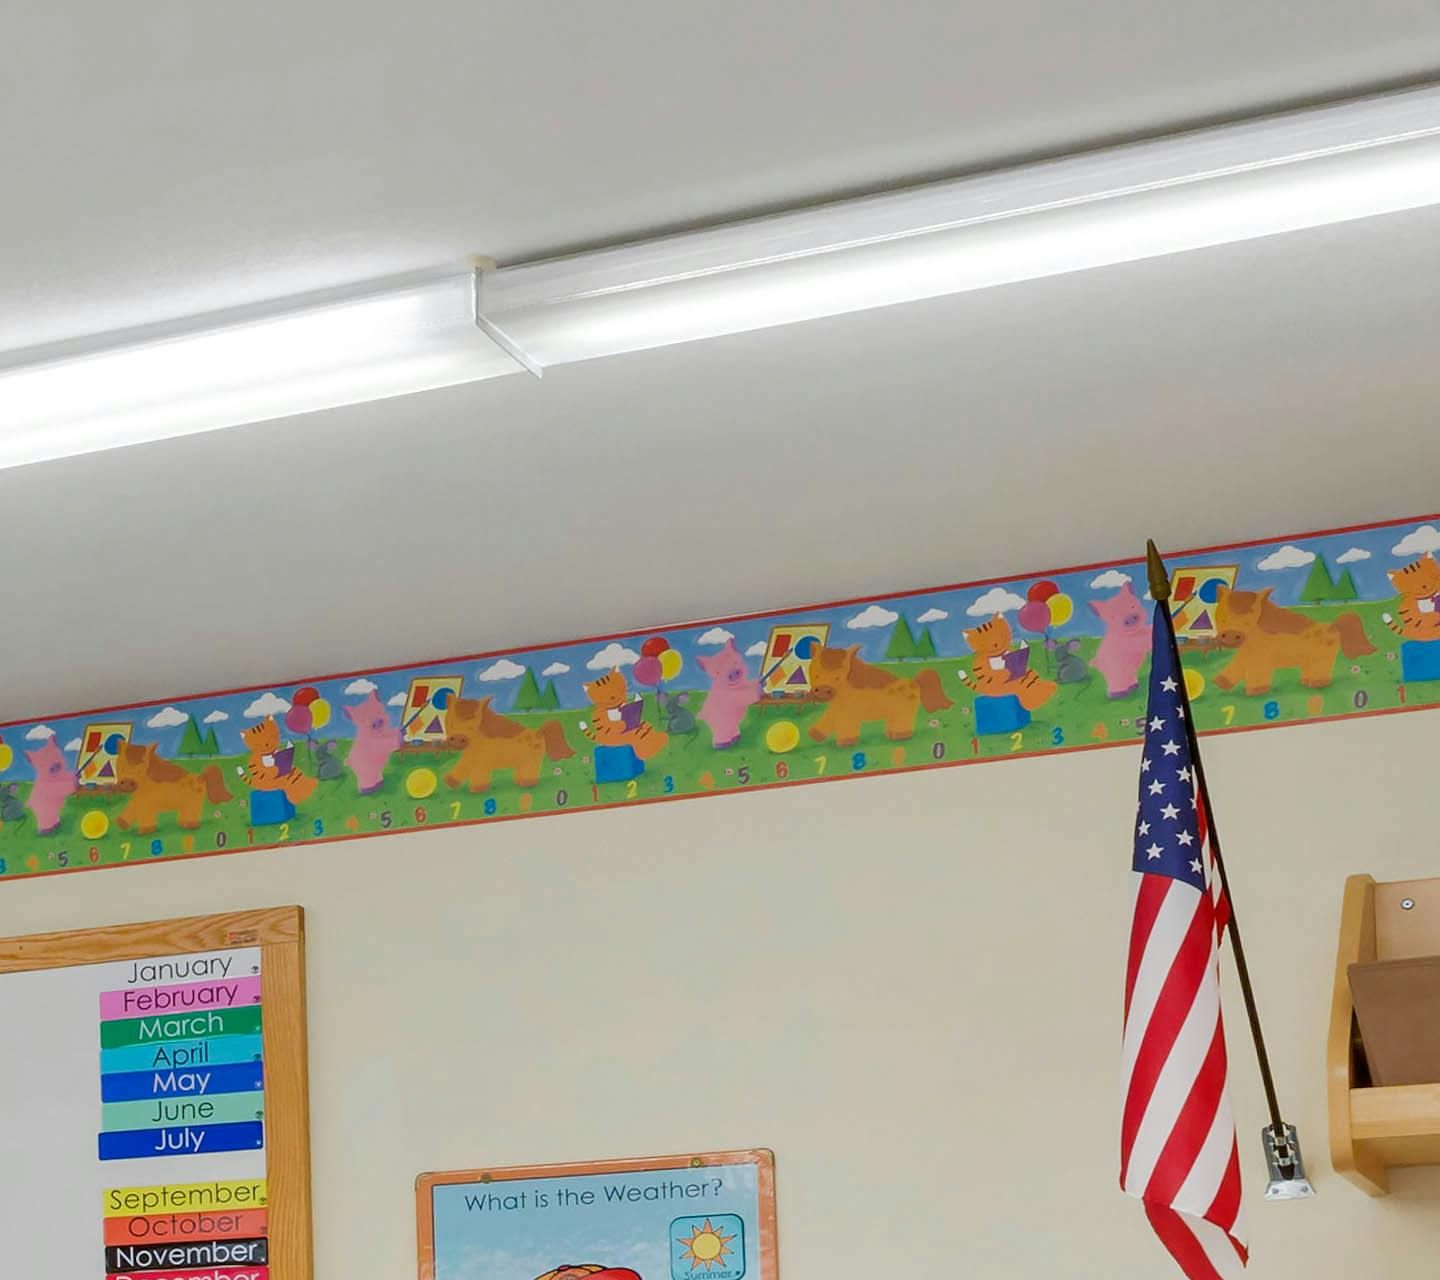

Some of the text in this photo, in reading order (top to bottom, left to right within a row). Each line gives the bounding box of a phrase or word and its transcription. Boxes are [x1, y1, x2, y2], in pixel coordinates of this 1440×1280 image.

[933, 728, 1064, 760] 0 1 2 3
[128, 956, 232, 984] January
[123, 984, 238, 1012] February
[139, 1012, 223, 1040] March
[152, 1041, 208, 1069] April
[153, 1072, 211, 1095] May
[152, 1100, 214, 1122] June
[154, 1128, 205, 1152] July
[110, 1183, 260, 1212] September
[465, 1178, 723, 1212] What is the Weather?
[128, 1213, 242, 1237] October
[116, 1241, 257, 1268] November
